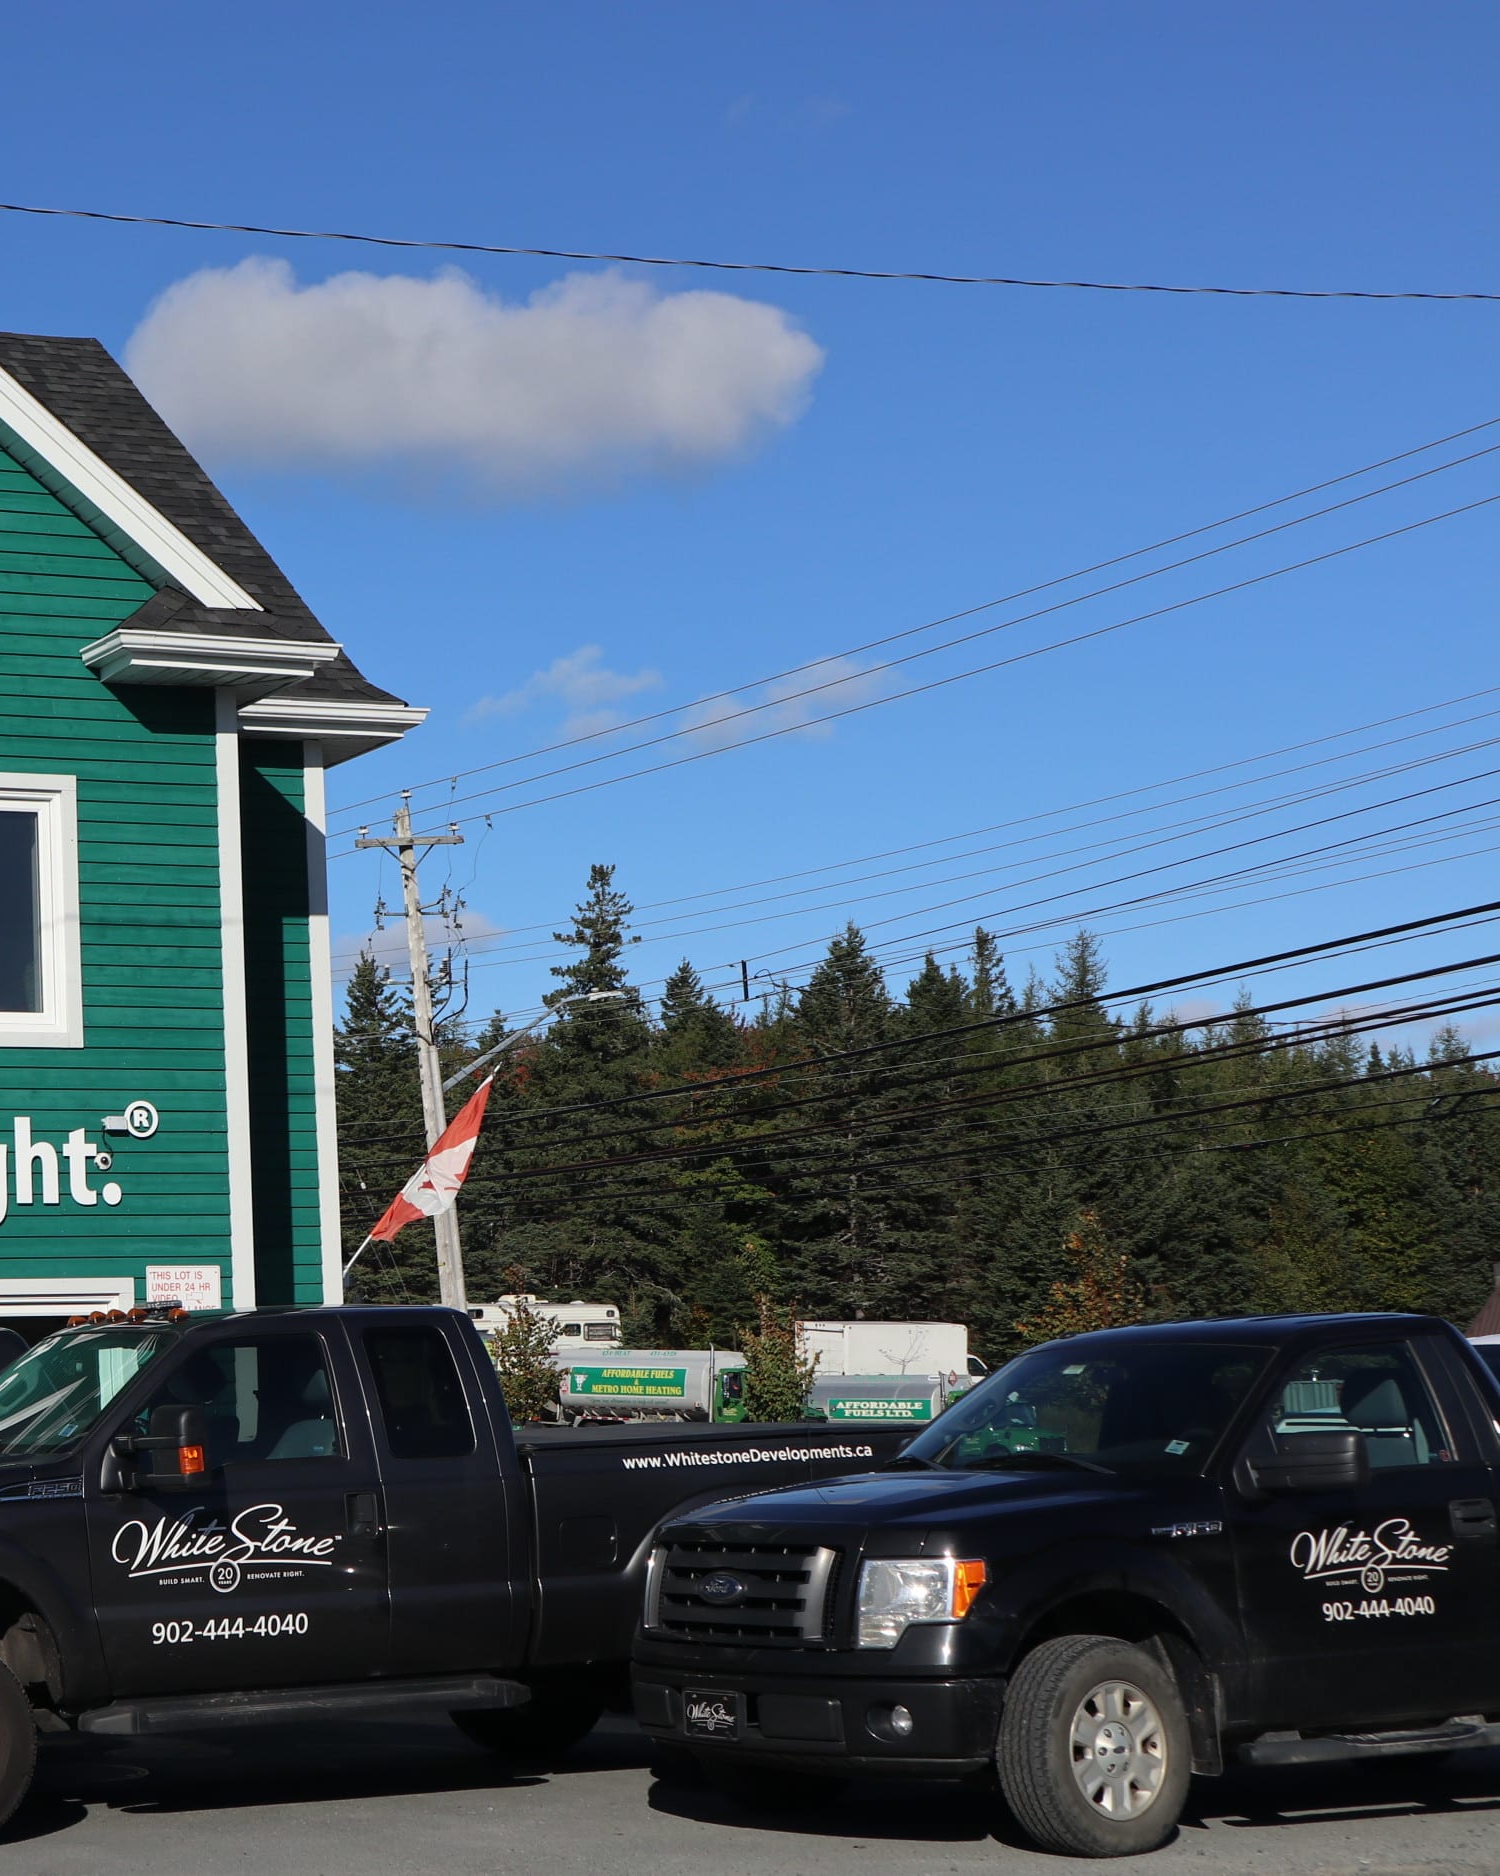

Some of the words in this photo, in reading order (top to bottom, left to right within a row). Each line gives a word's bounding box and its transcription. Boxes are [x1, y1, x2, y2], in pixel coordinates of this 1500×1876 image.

[152, 1271, 171, 1280] THIS
[175, 1271, 190, 1280] LOT
[194, 1271, 203, 1280] IS
[152, 1282, 181, 1292] UNDER
[184, 1282, 195, 1292] 24
[199, 1282, 211, 1292] HR
[602, 1369, 650, 1379] AFFORDABLE
[651, 1369, 675, 1379] FUELS
[591, 1384, 619, 1394] METRO
[620, 1385, 645, 1395] HOME
[646, 1386, 682, 1395] HEATING
[836, 1401, 923, 1410] AFFORDABLE
[844, 1409, 884, 1417] FUELS
[885, 1409, 915, 1418] LTD.
[622, 1446, 873, 1470] www.WhitestoneDevelopments.ca
[217, 1567, 233, 1580] 20
[247, 1572, 281, 1581] RENOVATE
[1366, 1571, 1379, 1583] 20
[159, 1578, 179, 1586] BUILD
[1322, 1596, 1435, 1621] 902-444-4040
[152, 1613, 309, 1645] 902-444-4040
